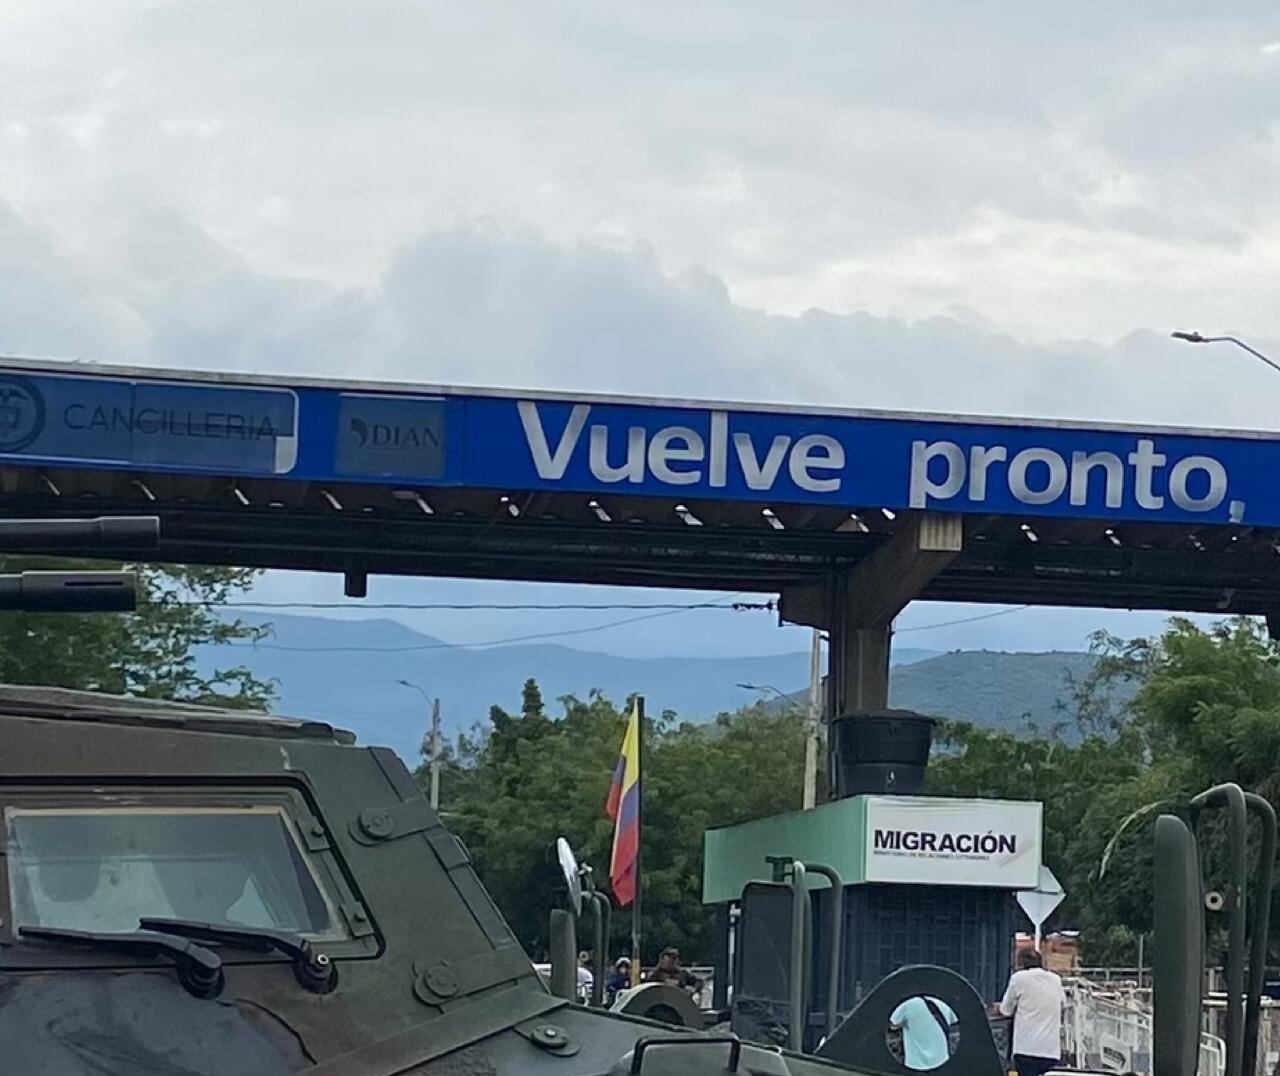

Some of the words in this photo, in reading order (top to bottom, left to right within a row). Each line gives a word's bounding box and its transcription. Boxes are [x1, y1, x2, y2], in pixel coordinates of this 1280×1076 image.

[63, 403, 276, 439] CANCILLERÍA
[373, 424, 439, 447] DIAN
[516, 402, 847, 492] Vuelve
[910, 440, 1240, 523] pronto,
[874, 830, 1017, 854] MIGRACIÓN
